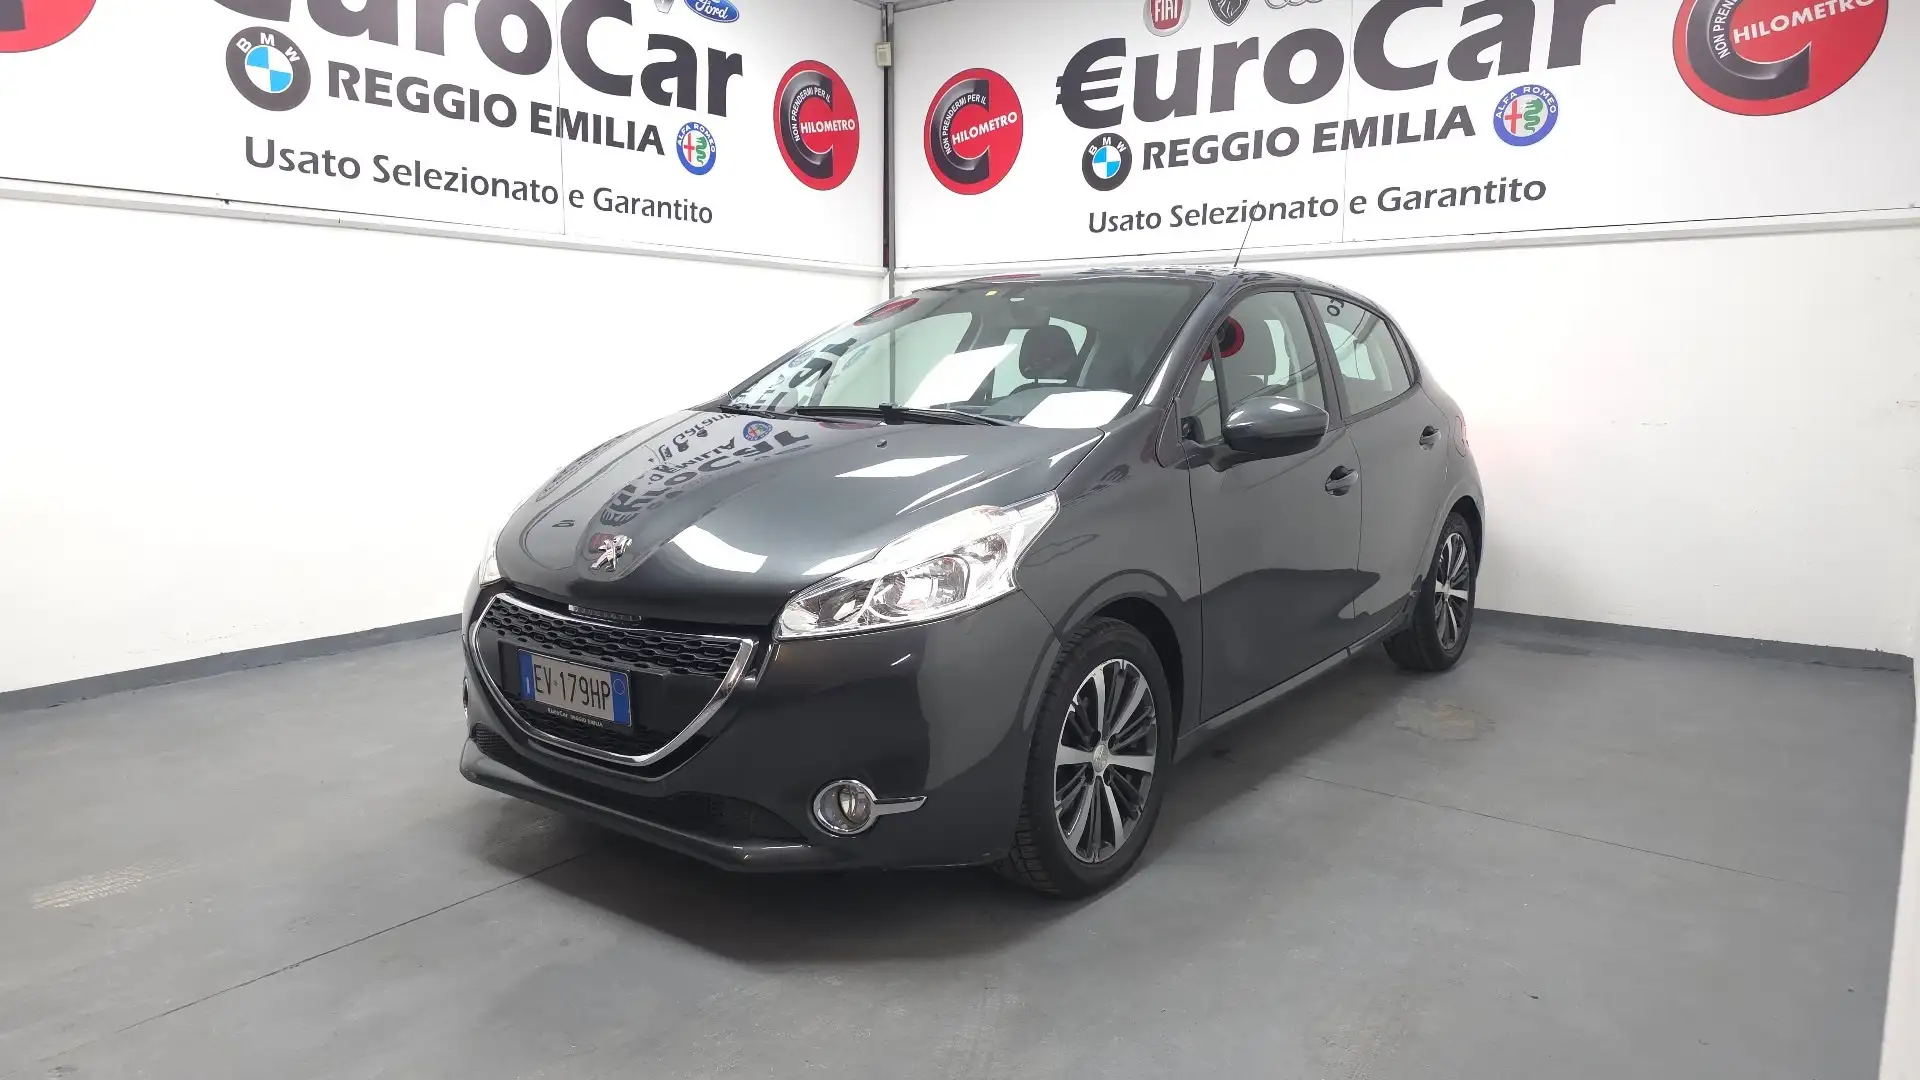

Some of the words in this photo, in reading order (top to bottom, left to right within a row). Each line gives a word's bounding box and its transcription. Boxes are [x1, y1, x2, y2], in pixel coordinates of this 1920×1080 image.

[694, 1, 728, 19] Ford
[236, 32, 300, 62] BMW
[1713, 34, 1731, 59] NON
[328, 60, 517, 128] REGGIO
[530, 101, 665, 156] EMILIA
[1496, 91, 1518, 119] ALFA
[1523, 86, 1557, 113] ROMEO
[792, 123, 800, 141] NON
[942, 137, 952, 155] NON
[967, 94, 980, 103] PER
[1142, 126, 1300, 171] REGGIO
[1312, 105, 1476, 154] EMILIA
[1088, 136, 1126, 156] BMW
[245, 136, 361, 180] Usato
[373, 154, 559, 205] Selezionato
[569, 189, 584, 208] e
[594, 187, 713, 224] Garantito
[1088, 207, 1161, 234] Usato
[1170, 195, 1339, 228] Selezionato
[1349, 195, 1367, 214] e
[1377, 177, 1547, 213] Garantito
